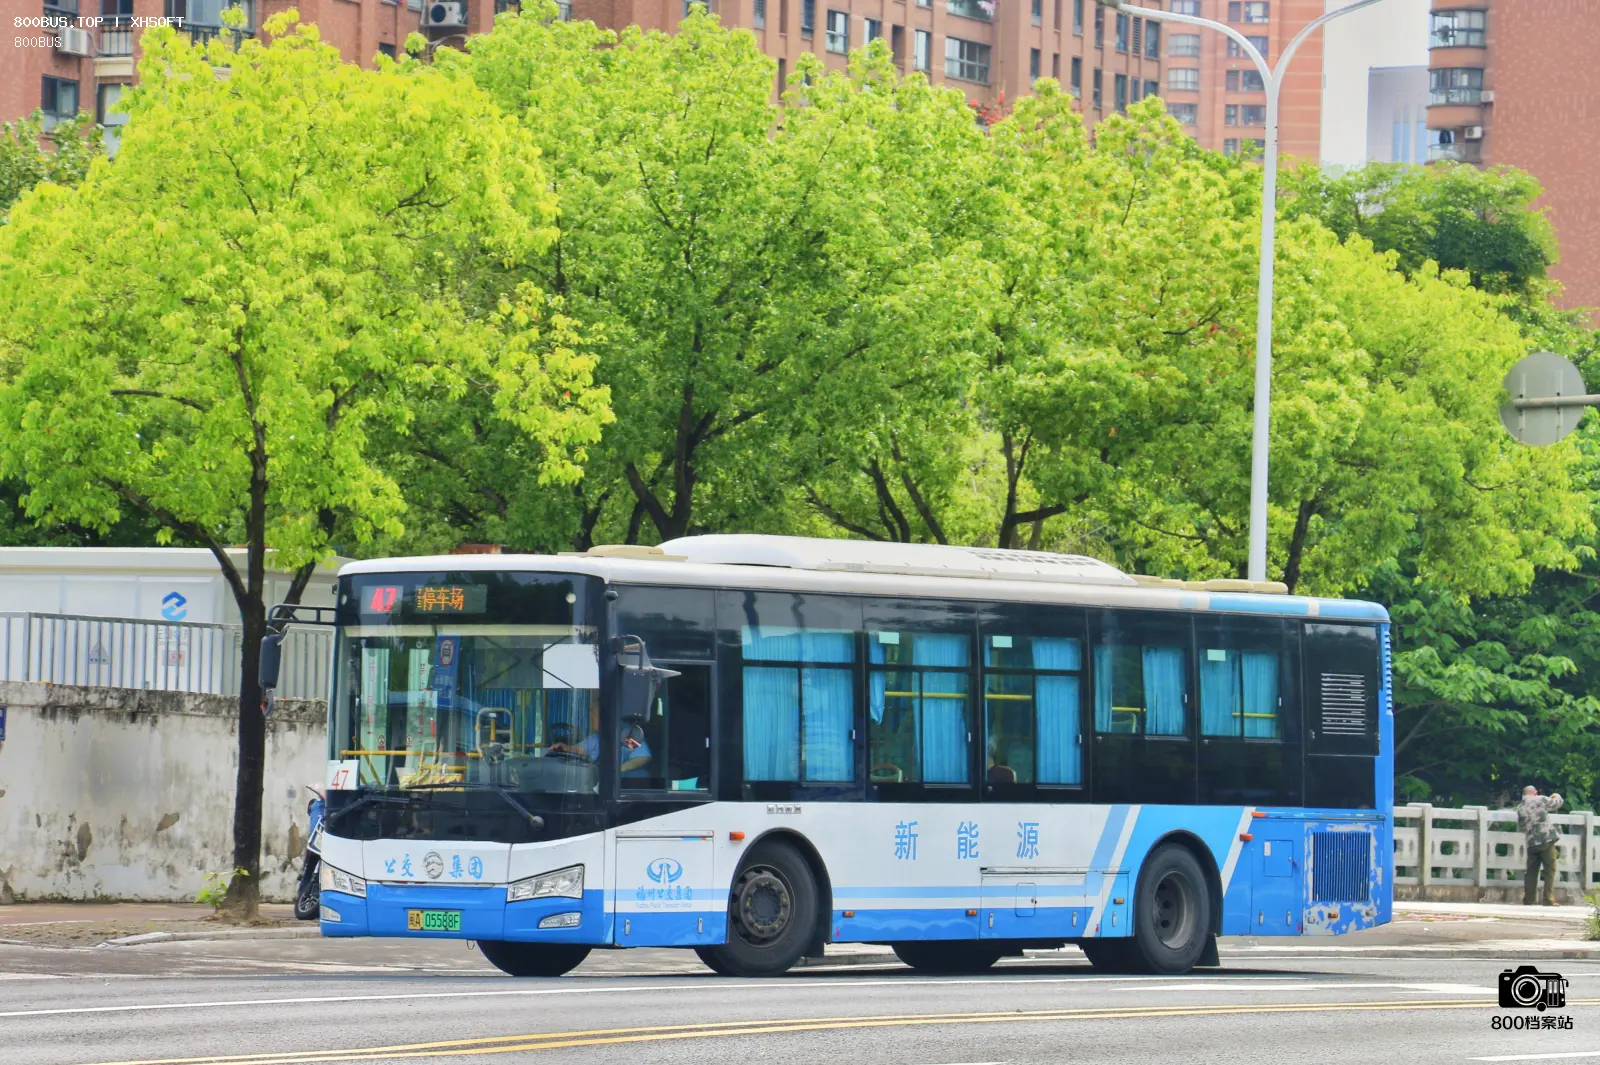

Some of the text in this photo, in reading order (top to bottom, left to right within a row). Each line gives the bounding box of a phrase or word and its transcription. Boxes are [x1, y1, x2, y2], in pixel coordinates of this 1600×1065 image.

[369, 587, 397, 613] 47
[331, 769, 349, 791] 47
[894, 820, 1040, 861] 新能源
[384, 853, 483, 879] 公交 集团
